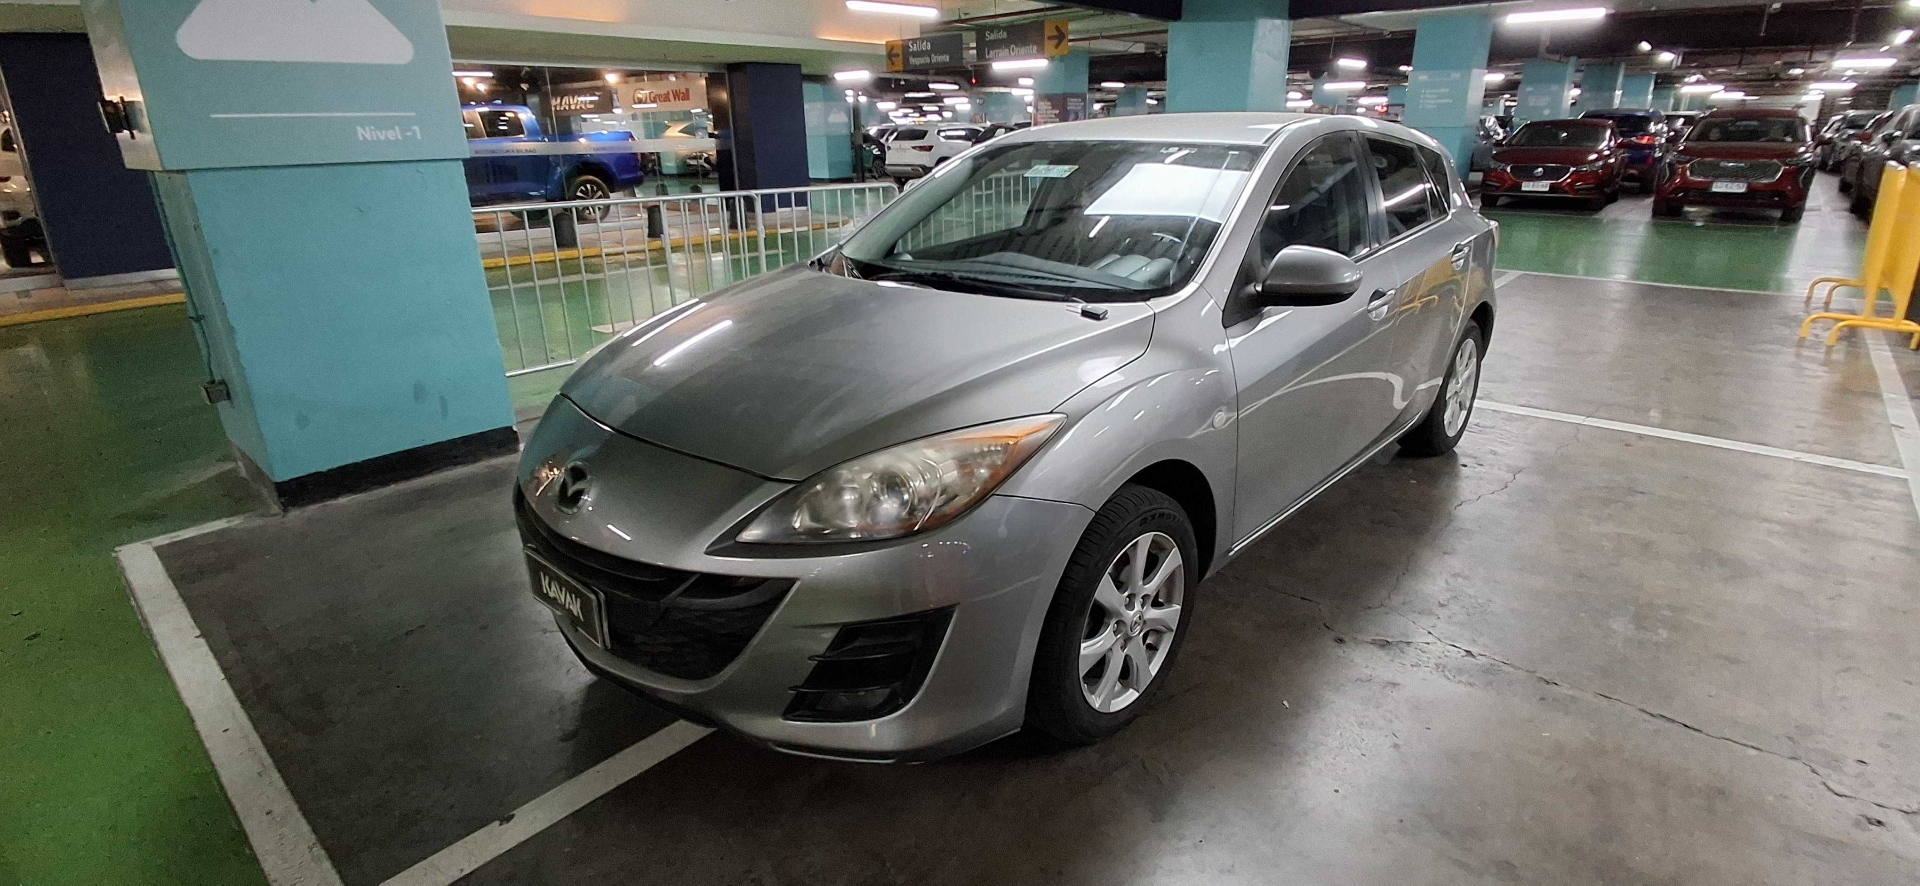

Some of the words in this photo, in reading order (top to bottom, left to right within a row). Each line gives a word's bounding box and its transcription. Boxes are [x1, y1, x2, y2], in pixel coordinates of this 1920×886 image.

[985, 29, 1008, 41] Salida
[908, 40, 931, 52] Salida
[1010, 44, 1037, 56] Oriente
[930, 53, 950, 63] Oriente
[551, 94, 595, 111] HAVAL
[650, 90, 671, 104] Great
[672, 87, 691, 102] Wall
[355, 125, 403, 141] Nivel
[405, 125, 421, 140] -1
[540, 571, 584, 622] KAVAK
